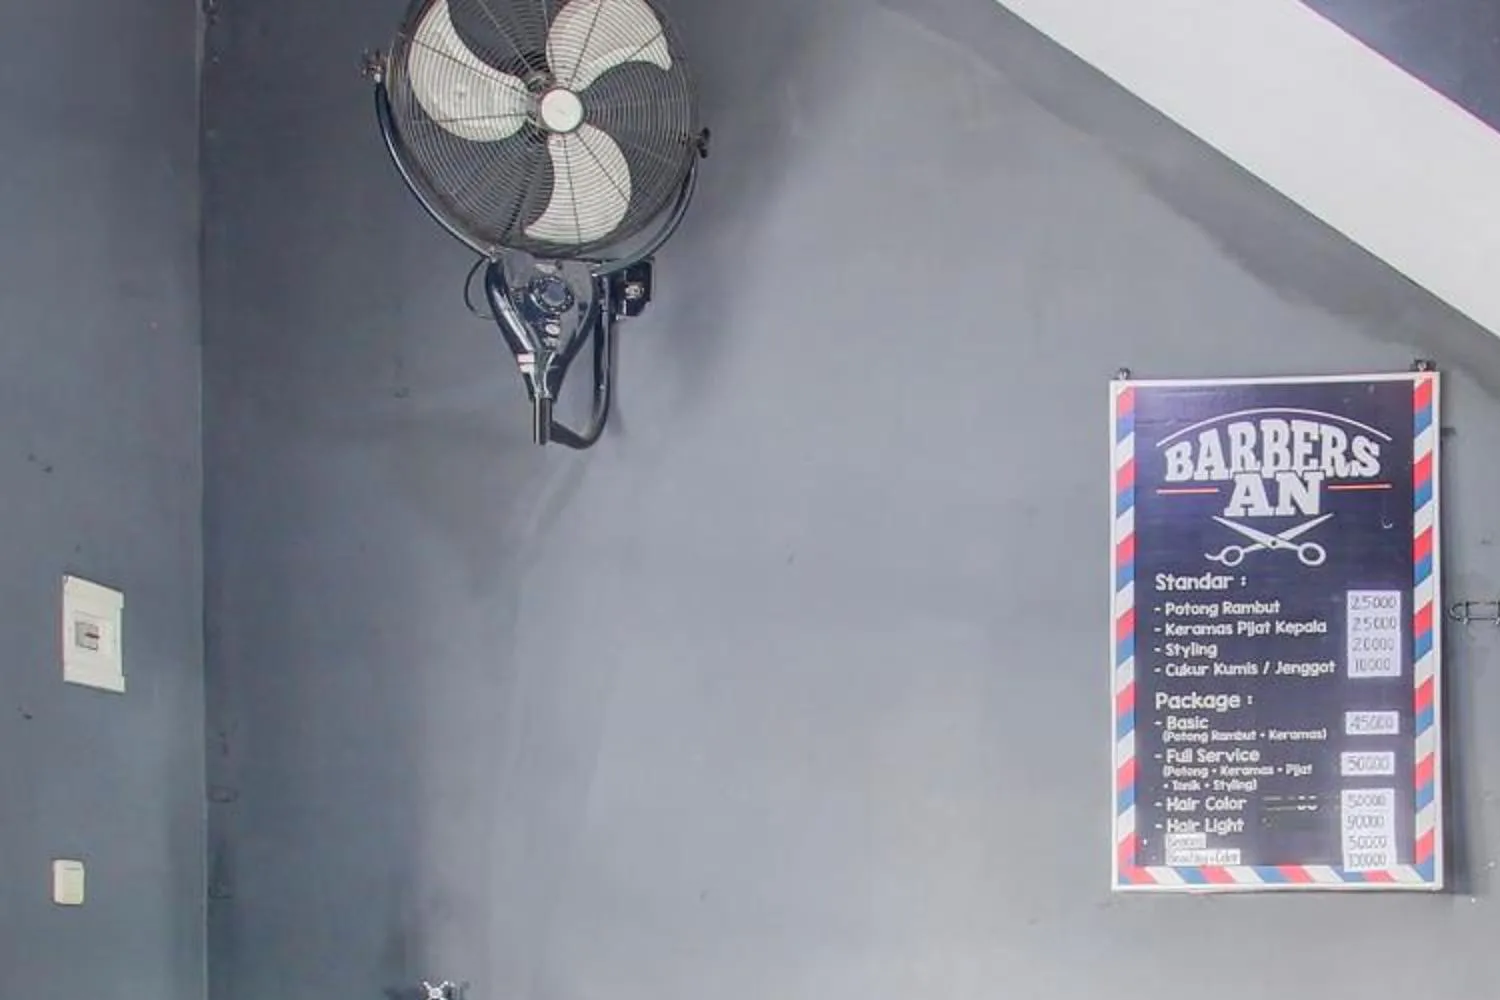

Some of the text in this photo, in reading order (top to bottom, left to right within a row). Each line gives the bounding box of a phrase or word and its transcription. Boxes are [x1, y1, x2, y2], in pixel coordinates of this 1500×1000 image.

[1164, 419, 1381, 482] BARBERS
[1223, 470, 1325, 517] AN
[1155, 572, 1234, 591] Standar
[1165, 600, 1280, 617] Potong Rambut
[1350, 595, 1397, 610] 25000
[1165, 620, 1327, 637] Keramas Pijat Kepala
[1351, 616, 1397, 631] 25000
[1165, 642, 1218, 658] Styling
[1165, 663, 1209, 677] Cukur
[1213, 661, 1259, 676] Kumis
[1275, 660, 1336, 677] Jenggot
[1155, 691, 1240, 712] Package
[1167, 715, 1209, 730] Basic
[1166, 747, 1260, 763] Full Service
[1166, 796, 1248, 812] Hair Color
[1167, 817, 1245, 836] Hair Light
